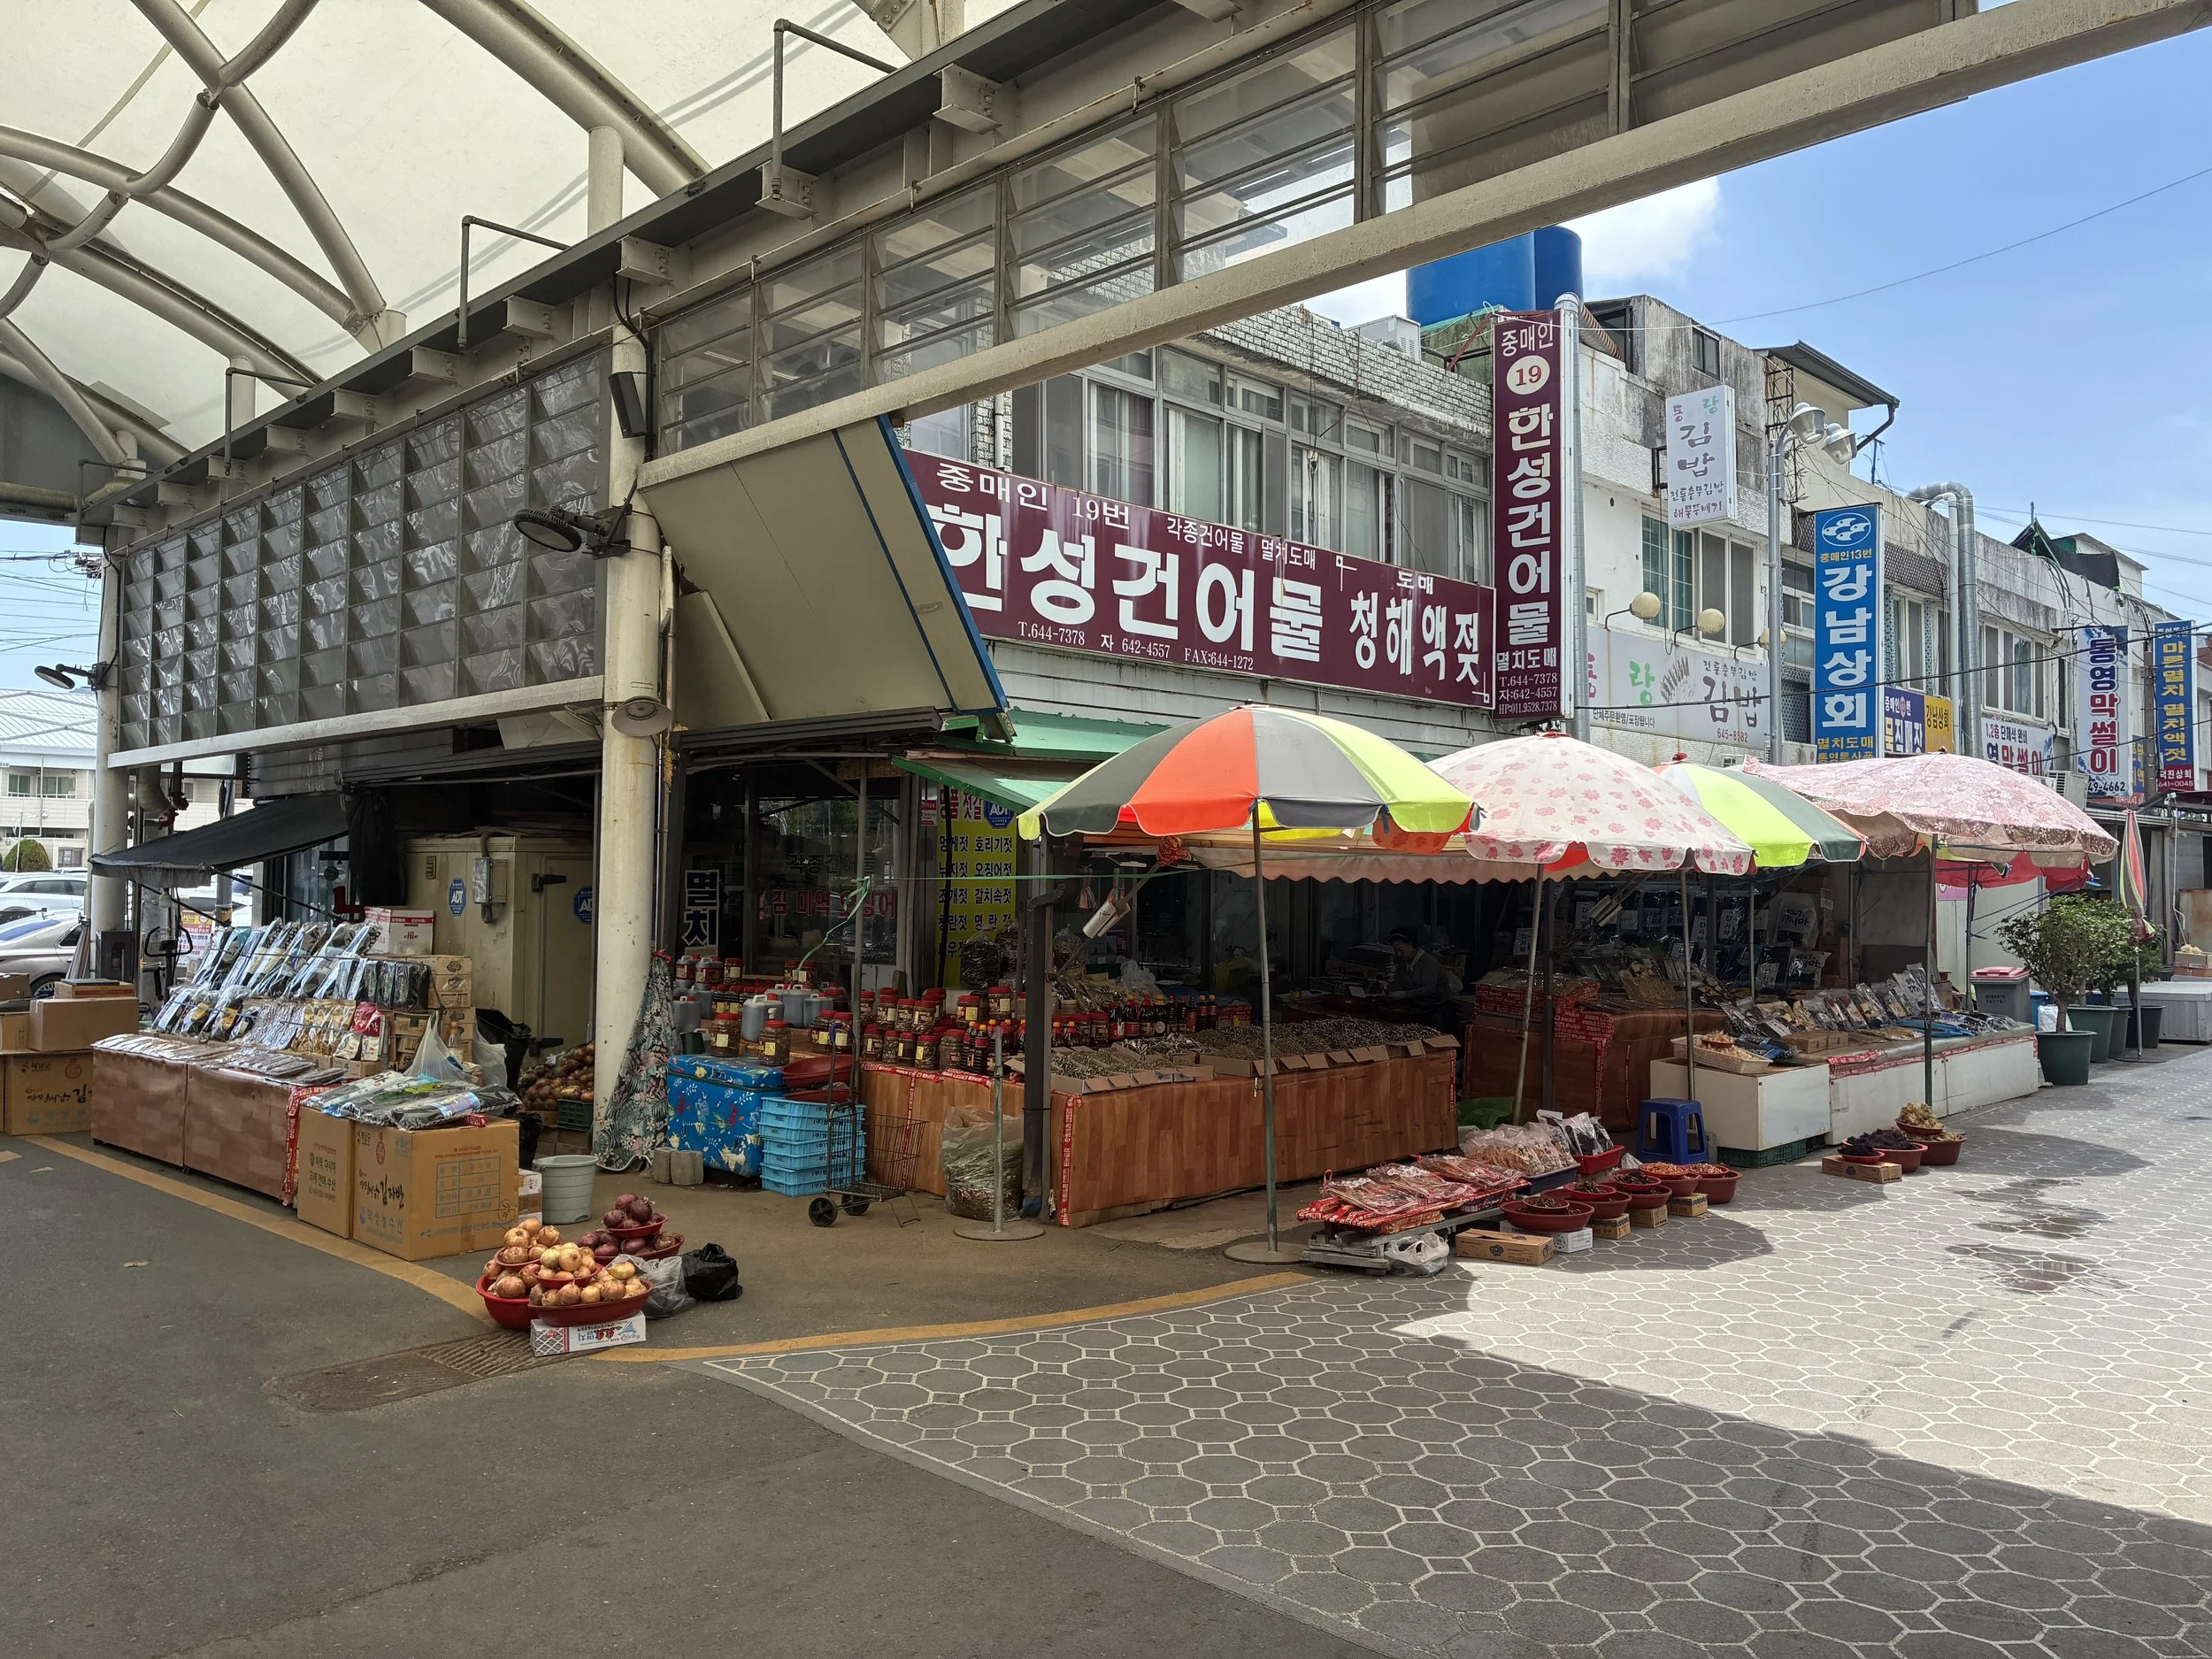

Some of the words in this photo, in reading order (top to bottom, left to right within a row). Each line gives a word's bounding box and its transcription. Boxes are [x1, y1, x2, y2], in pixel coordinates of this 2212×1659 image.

[1501, 321, 1554, 357] 중매인
[1515, 365, 1542, 387] 19
[1678, 422, 1716, 478] 김밥
[937, 462, 1048, 511] 중매인
[1072, 496, 1130, 530] 19번
[1167, 517, 1244, 554] 각종건어물
[1262, 538, 1317, 570] 멸치도매
[1396, 571, 1434, 595] 도매
[1507, 403, 1555, 645] 한성건어물
[926, 503, 1323, 664] 한성건어물
[1018, 621, 1085, 646] T.644-7378
[1101, 634, 1114, 651] 자
[1122, 640, 1171, 659] 642-4557
[1185, 647, 1254, 671] FAX:644-1272
[1821, 564, 1873, 729] 강남상회
[1496, 648, 1557, 672] 멸치도매
[1499, 672, 1557, 687] T.644-7378
[1499, 686, 1557, 702] 자:642-4557
[1702, 676, 1763, 728] 김밥
[1926, 704, 1949, 732] 강남상회
[1817, 735, 1874, 749] 멸치도매
[2001, 726, 2016, 742] 단체석
[963, 792, 982, 821] 젓갈
[975, 835, 1012, 853] 호리기젓
[975, 862, 1012, 878] 오징어젓
[450, 890, 464, 903] ADT
[772, 890, 787, 916] 김
[795, 890, 831, 916] 미역
[974, 887, 1011, 904] 갈치속젓
